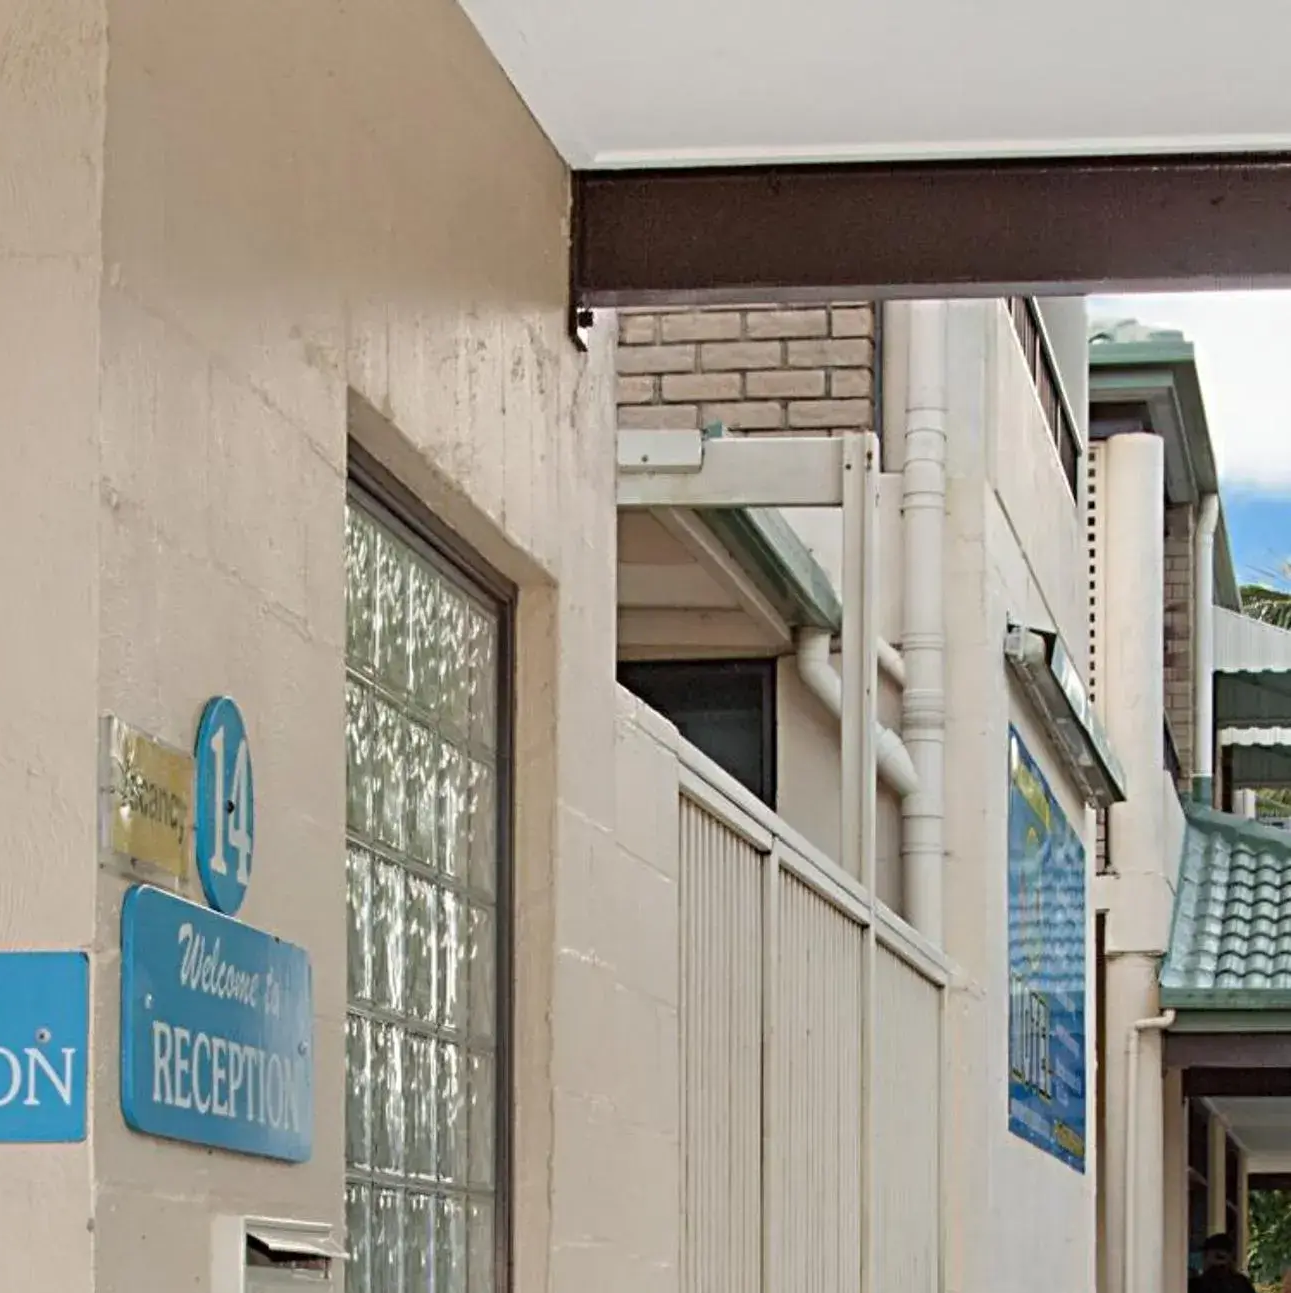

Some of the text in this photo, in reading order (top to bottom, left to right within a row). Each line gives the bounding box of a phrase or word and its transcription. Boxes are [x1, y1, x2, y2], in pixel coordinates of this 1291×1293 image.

[209, 726, 254, 886] 14
[178, 922, 281, 1021] Welcome to
[152, 1020, 306, 1133] RECEPTION
